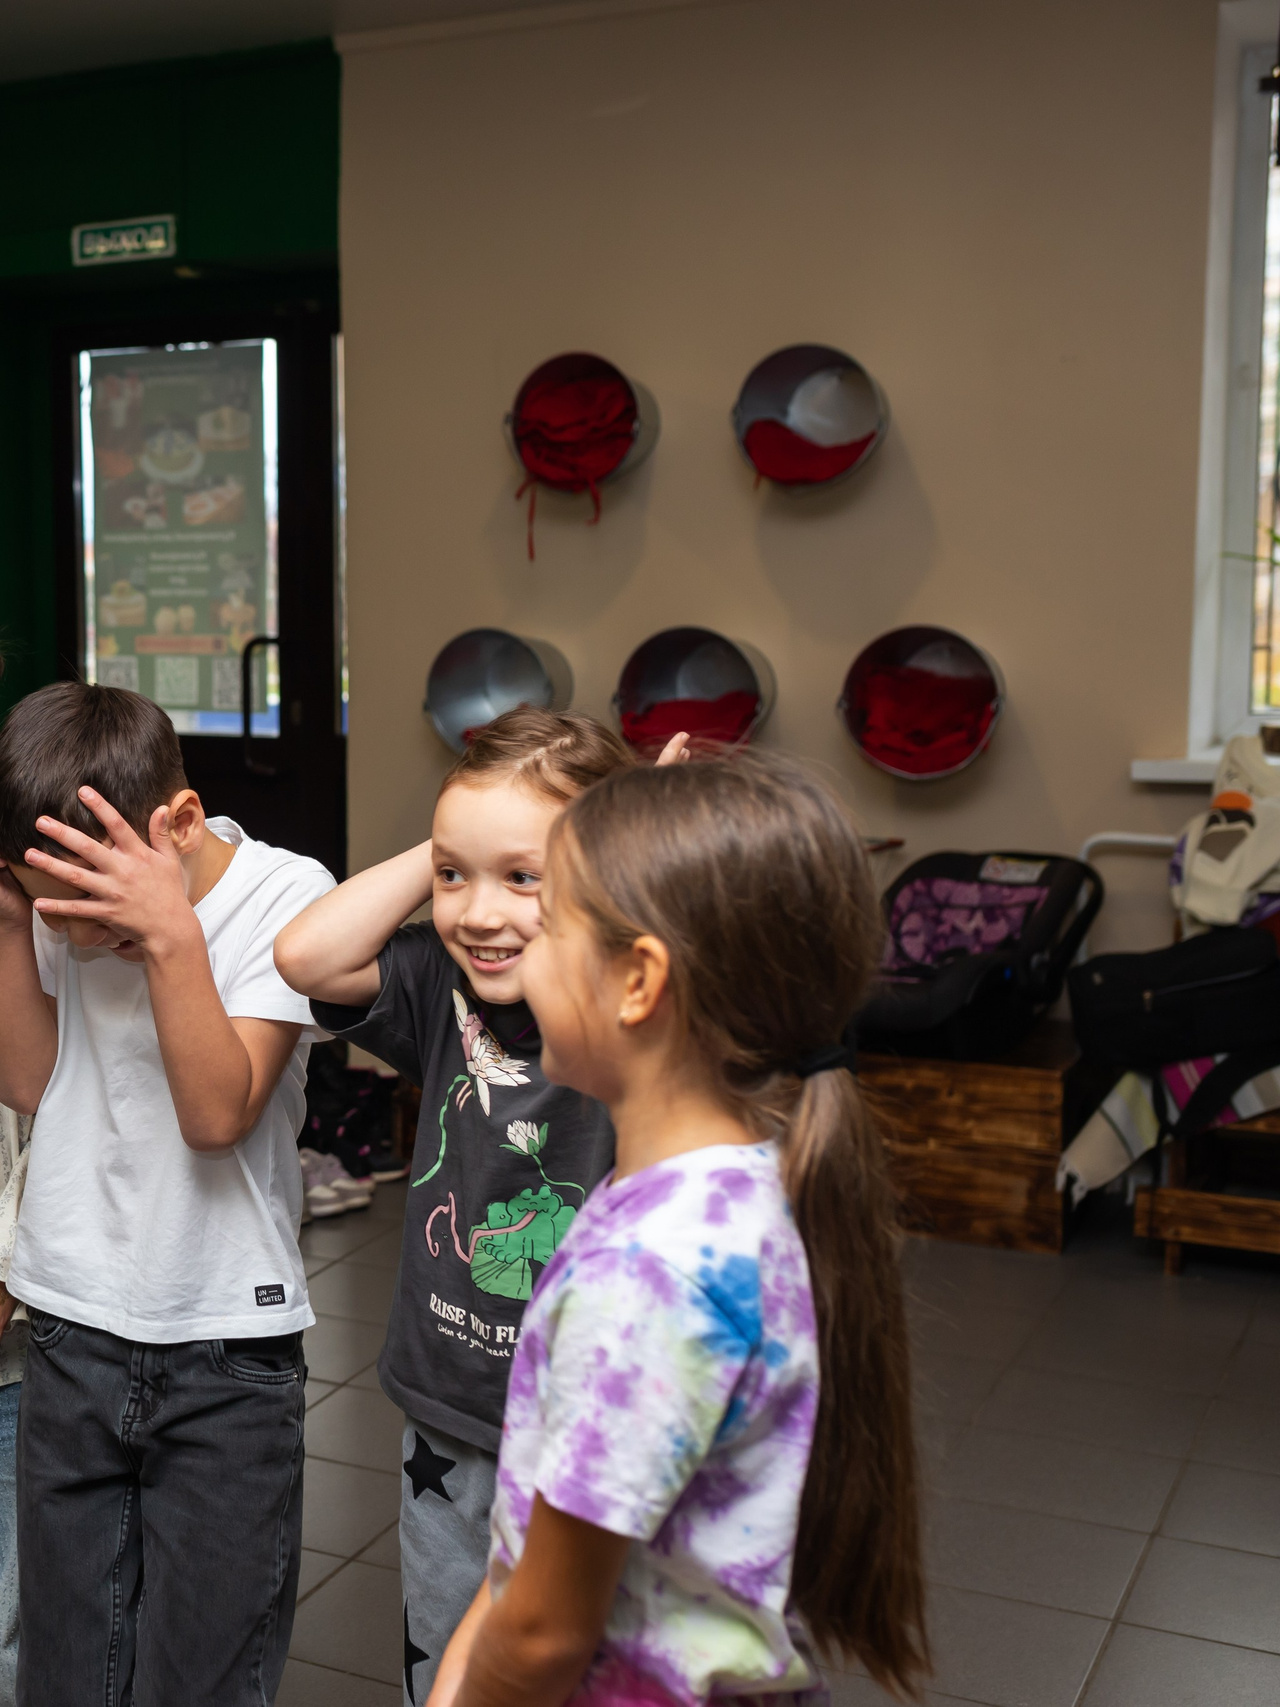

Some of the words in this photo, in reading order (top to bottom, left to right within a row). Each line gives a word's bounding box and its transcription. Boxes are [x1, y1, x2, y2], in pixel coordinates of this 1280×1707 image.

[83, 225, 166, 254] ВЫХОД
[258, 1294, 282, 1304] LIMITED
[429, 1292, 466, 1326] RAISE
[470, 1313, 491, 1340] YOU
[495, 1325, 524, 1344] FL
[456, 1331, 467, 1341] to
